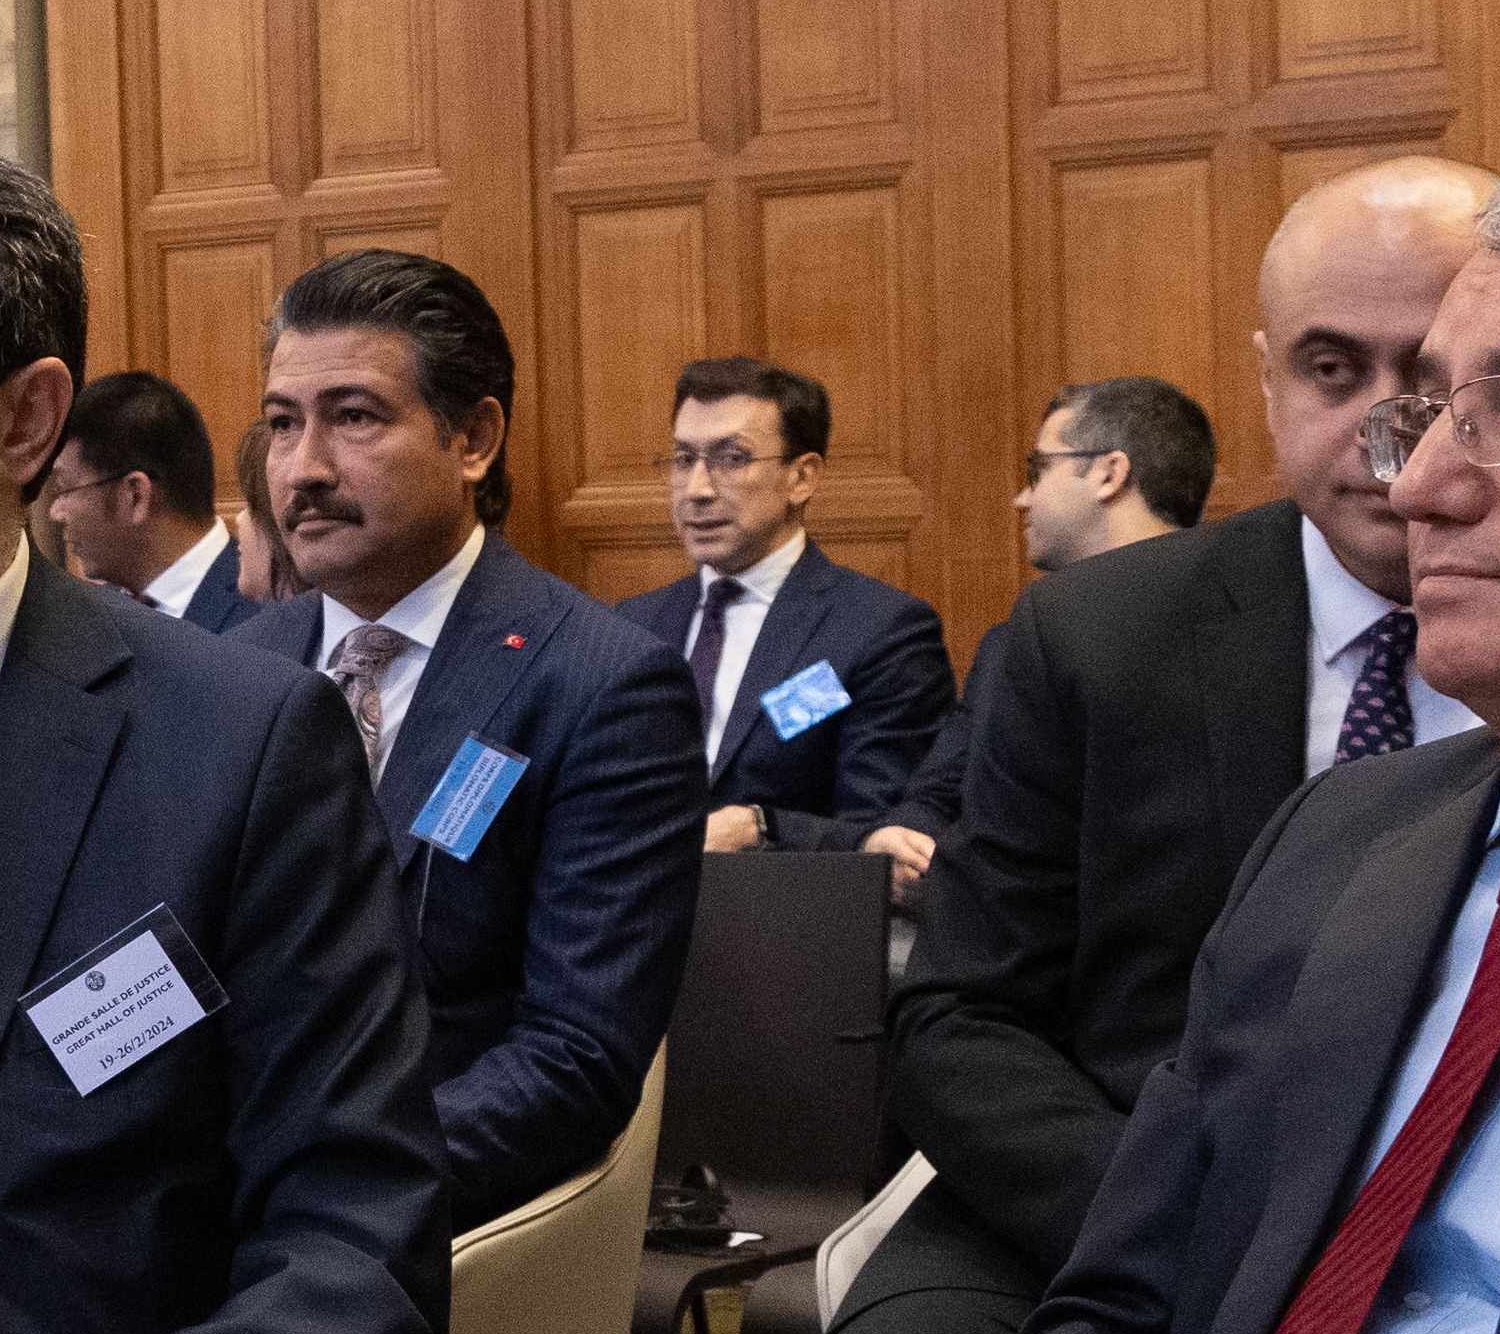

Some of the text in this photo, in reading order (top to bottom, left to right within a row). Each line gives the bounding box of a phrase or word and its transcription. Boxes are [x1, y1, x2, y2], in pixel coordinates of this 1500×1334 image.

[52, 963, 171, 1046] GRANDE SALLE DE JUSTICE
[66, 979, 175, 1055] GREAT HALL OF JUSTICE
[99, 1015, 175, 1070] 19-26/2/2024
